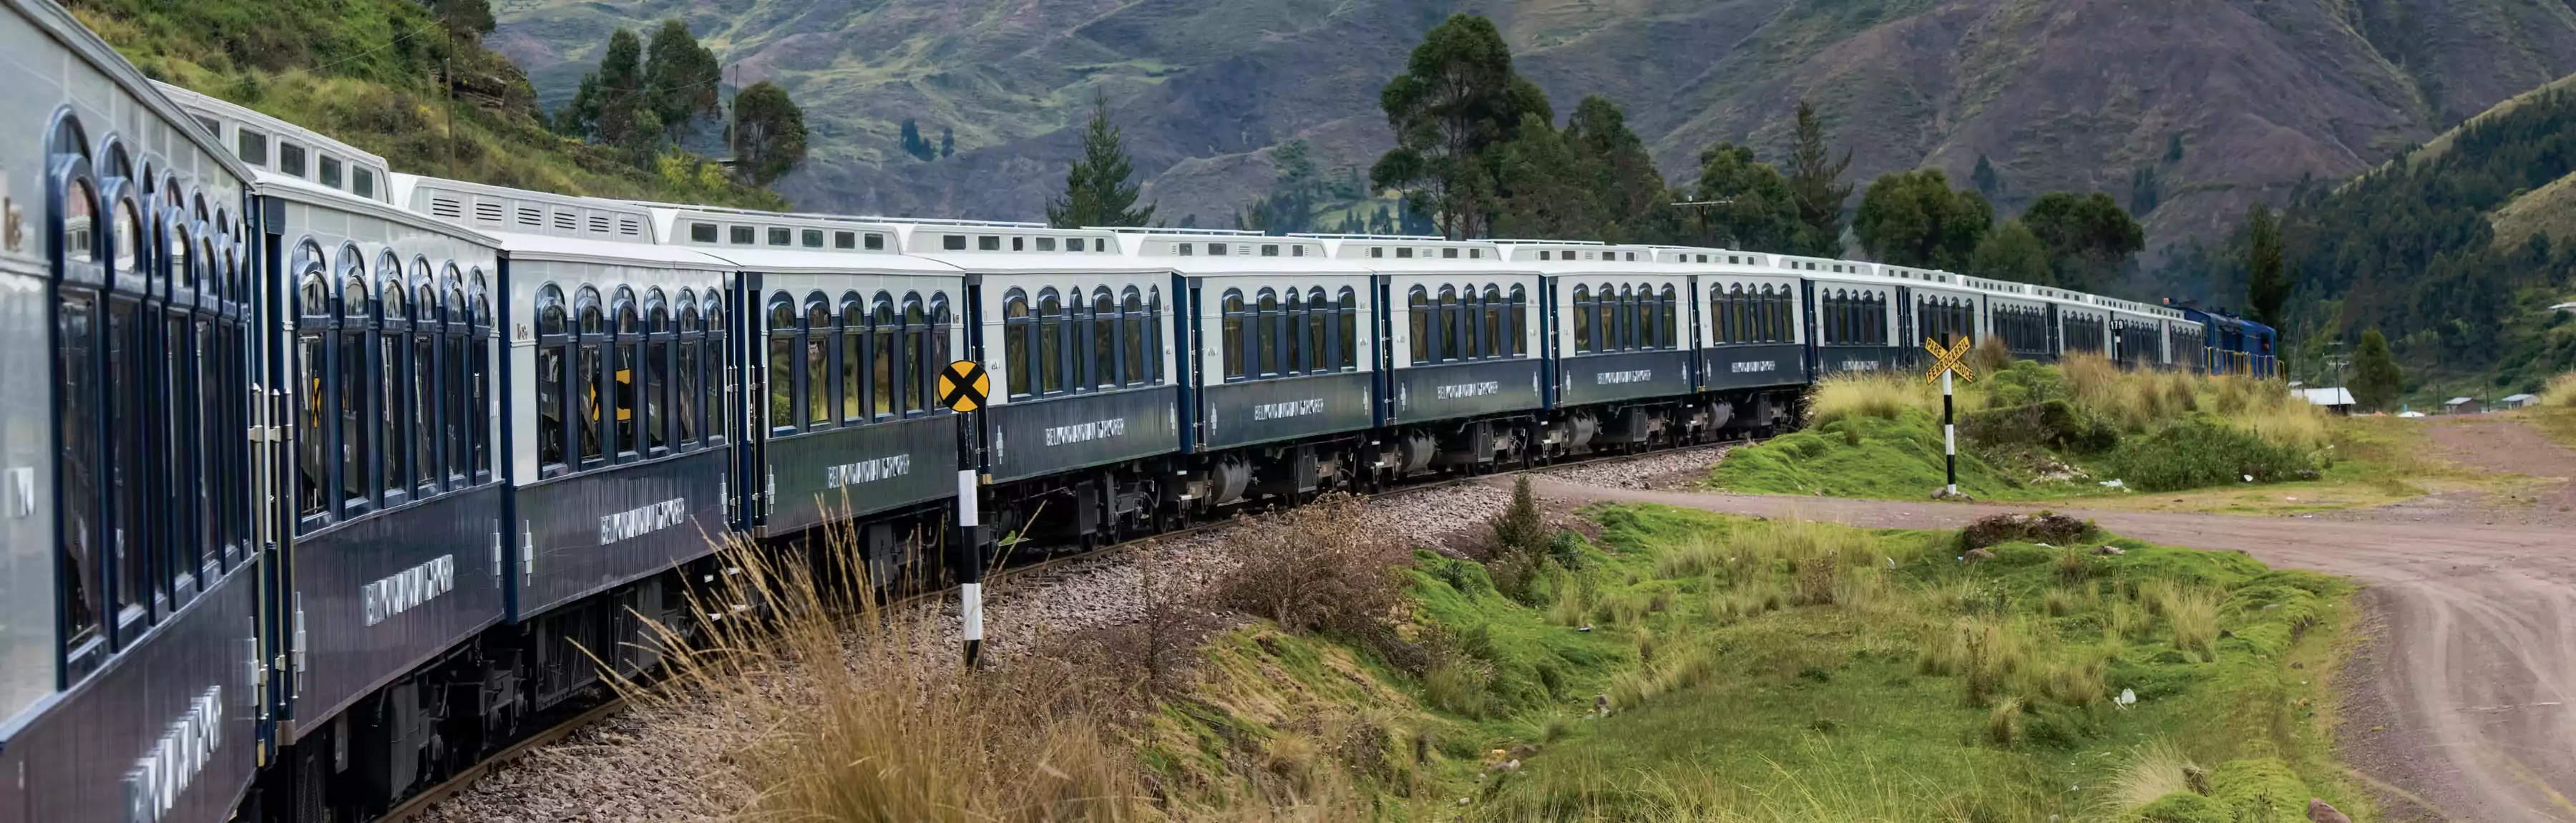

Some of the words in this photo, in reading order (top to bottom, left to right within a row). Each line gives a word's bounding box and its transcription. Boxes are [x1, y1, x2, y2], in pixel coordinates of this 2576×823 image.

[2110, 321, 2123, 329] 179
[1926, 339, 1942, 356] PARE
[1954, 361, 1973, 379] CRUCE
[1928, 339, 1968, 381] FERROCARRIL
